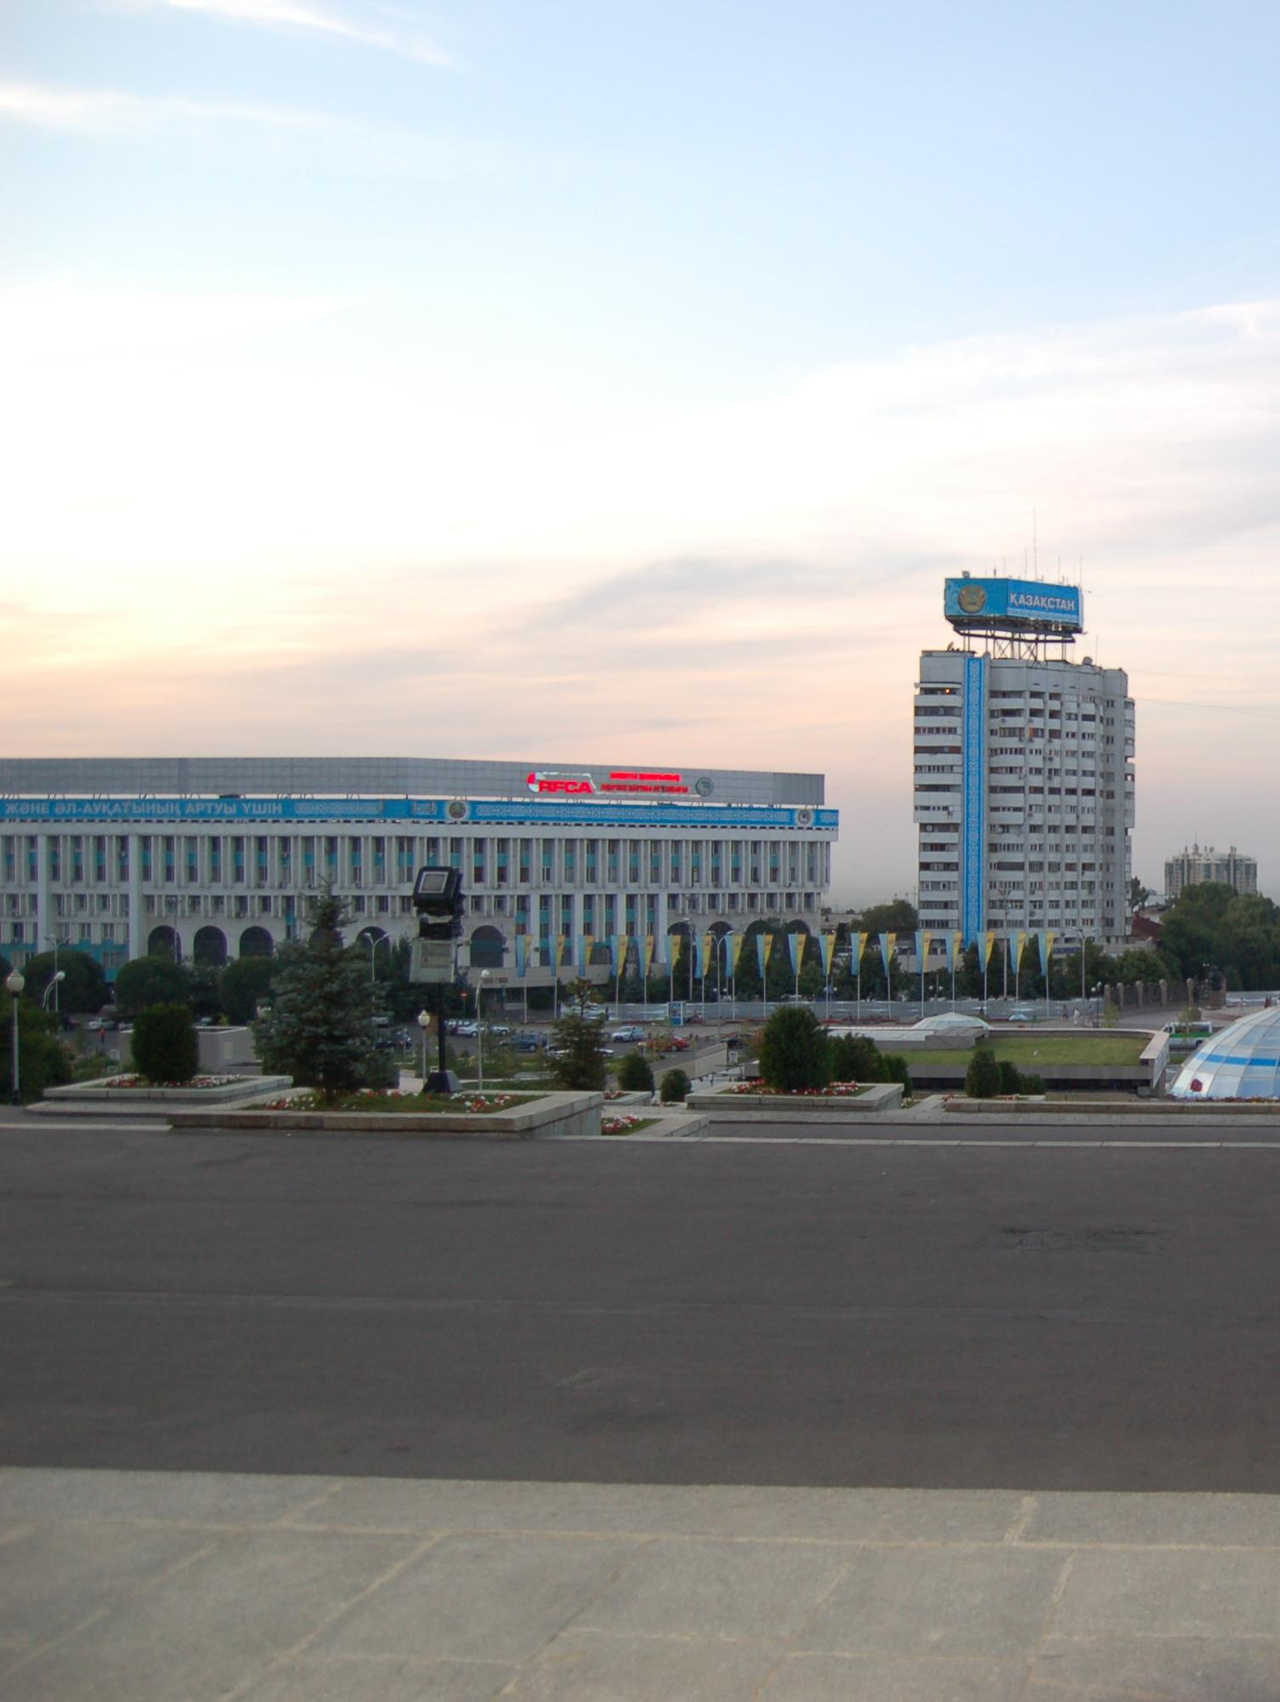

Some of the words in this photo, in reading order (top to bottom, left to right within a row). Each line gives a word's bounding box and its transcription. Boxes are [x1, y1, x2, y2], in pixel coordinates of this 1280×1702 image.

[1009, 592, 1075, 611] ҚАЗАҚСТАН
[538, 780, 593, 794] RFCA
[5, 802, 50, 815] ЖӘНЕ
[54, 802, 181, 816] ӘЛ-АУҚАТЫНЫҢ
[185, 802, 237, 814] АРТУЫ
[242, 802, 282, 814] ҮШІН
